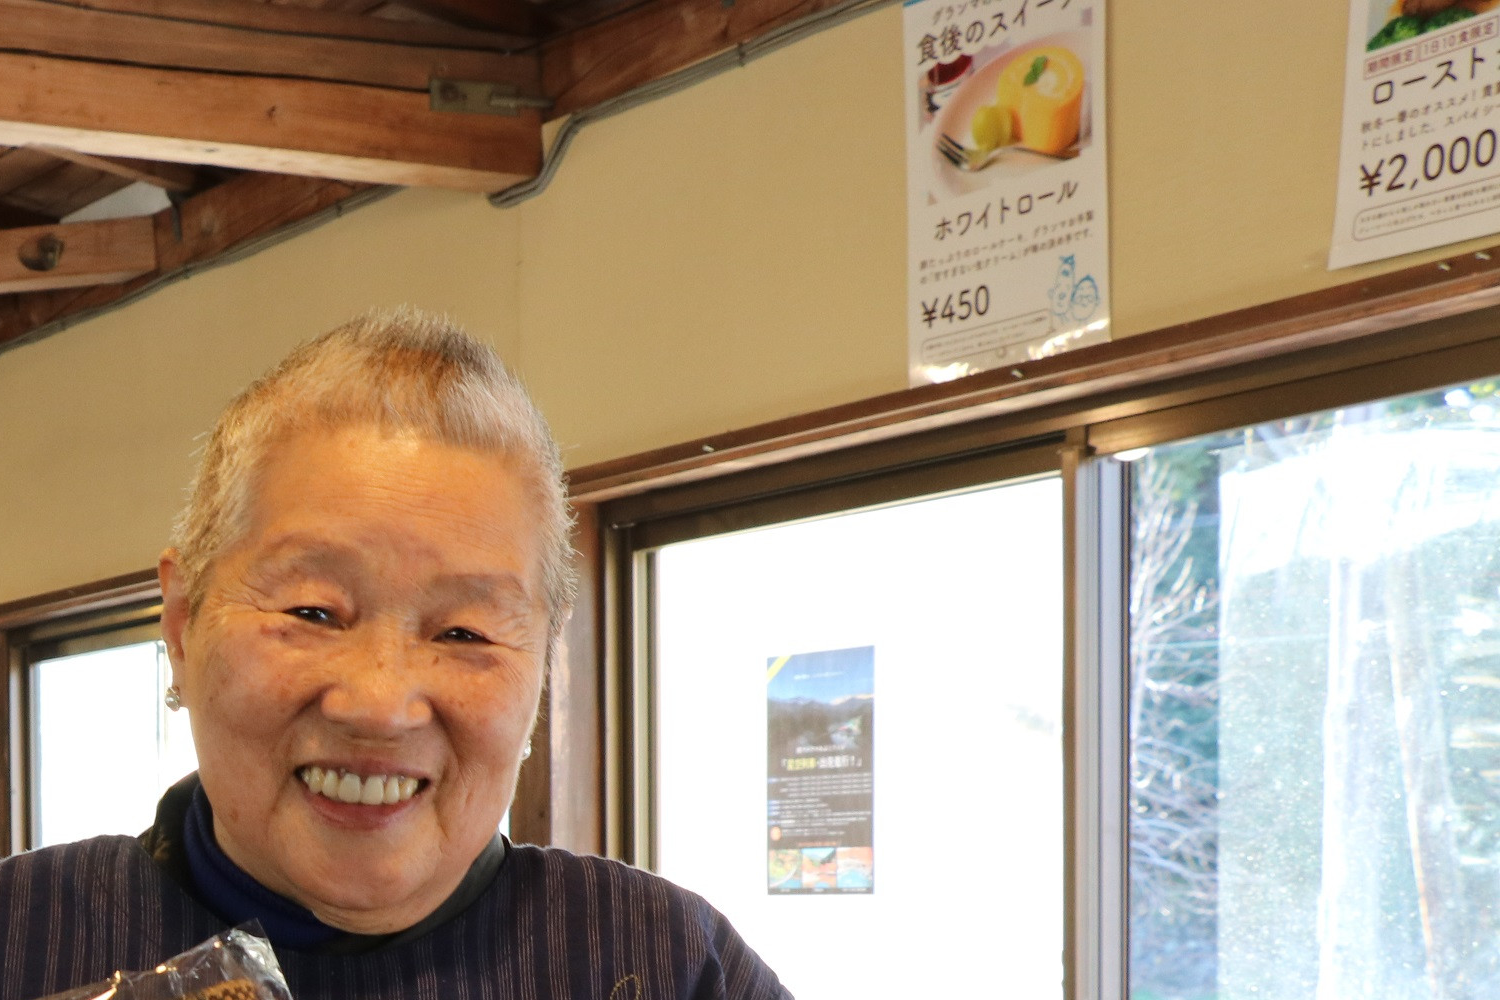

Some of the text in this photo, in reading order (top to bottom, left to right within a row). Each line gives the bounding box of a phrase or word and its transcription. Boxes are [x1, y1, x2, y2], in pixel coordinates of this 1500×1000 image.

[1373, 47, 1500, 105] ロースト
[1360, 128, 1497, 197] ¥2,000
[934, 181, 1079, 241] ホワイトロール
[922, 284, 990, 329] ¥450
